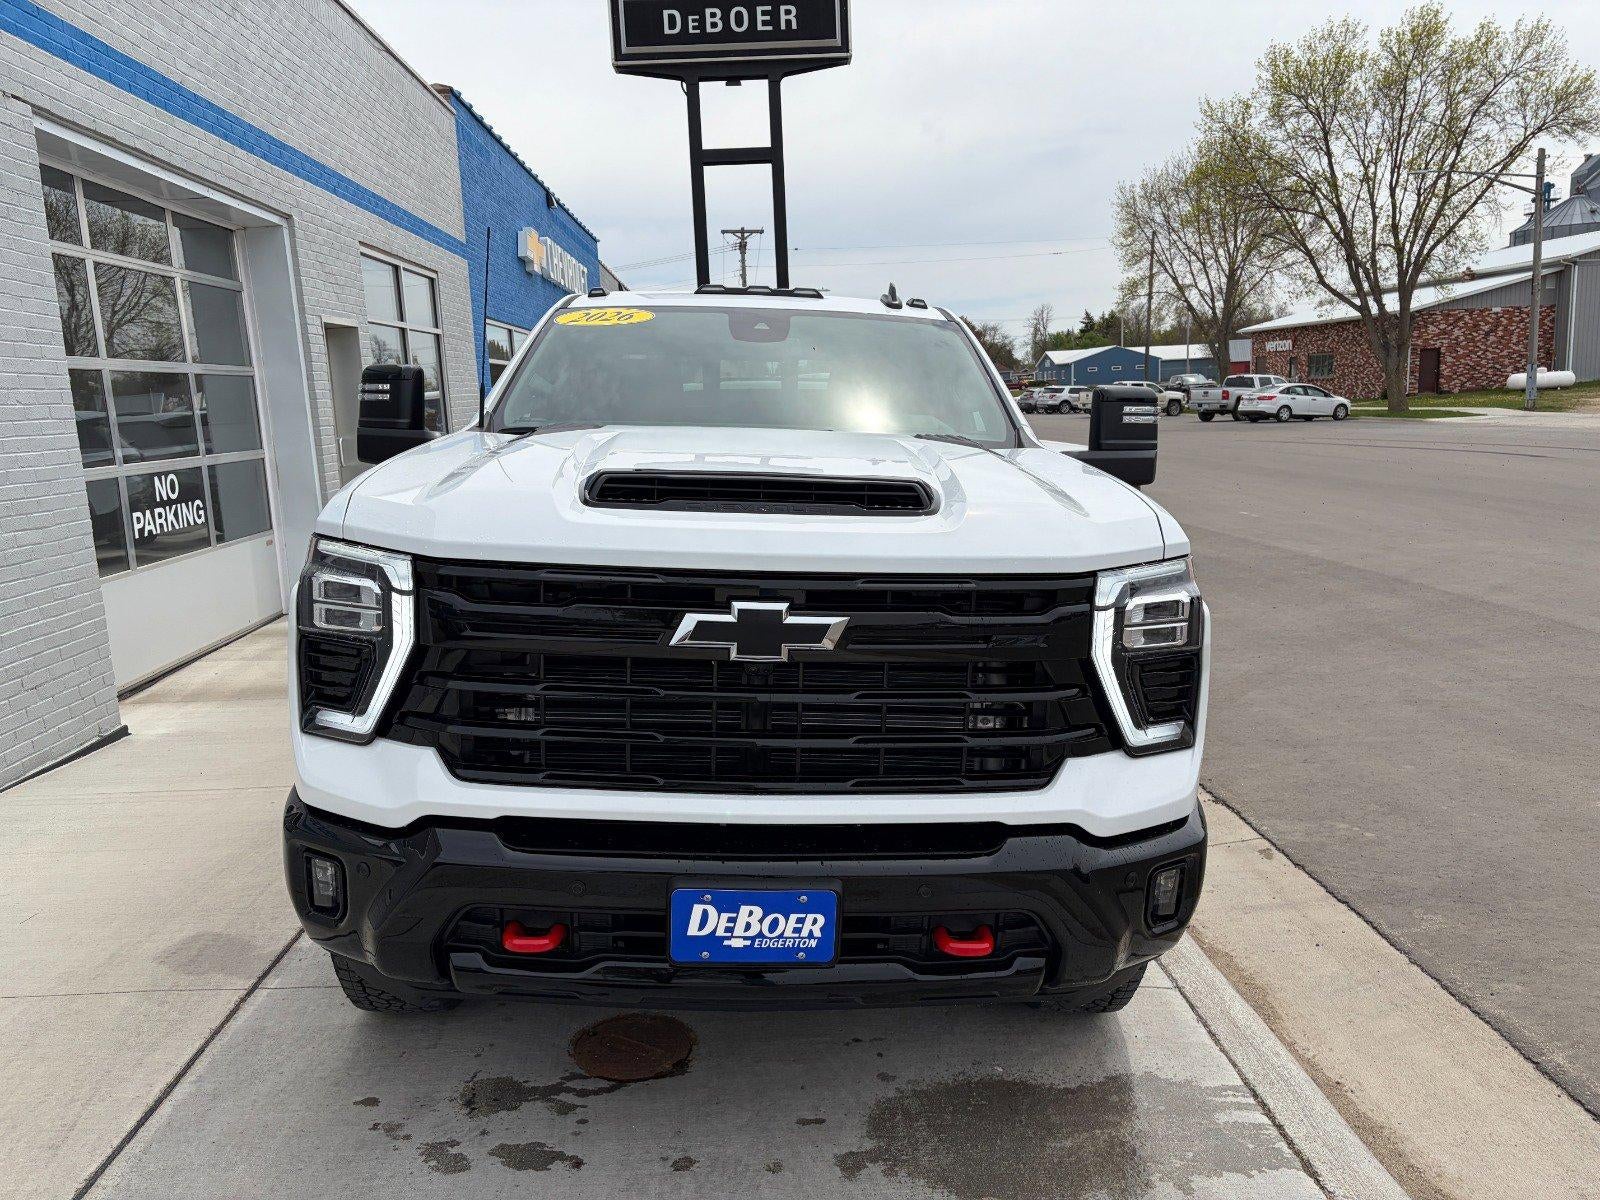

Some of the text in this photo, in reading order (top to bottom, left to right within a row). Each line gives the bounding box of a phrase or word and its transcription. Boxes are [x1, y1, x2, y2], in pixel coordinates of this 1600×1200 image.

[544, 237, 588, 295] CHEVROLET
[567, 311, 633, 324] 2026
[1265, 338, 1292, 352] verizon
[153, 473, 179, 501] NO
[132, 499, 206, 539] PARKING
[754, 938, 818, 949] EDGERTON
